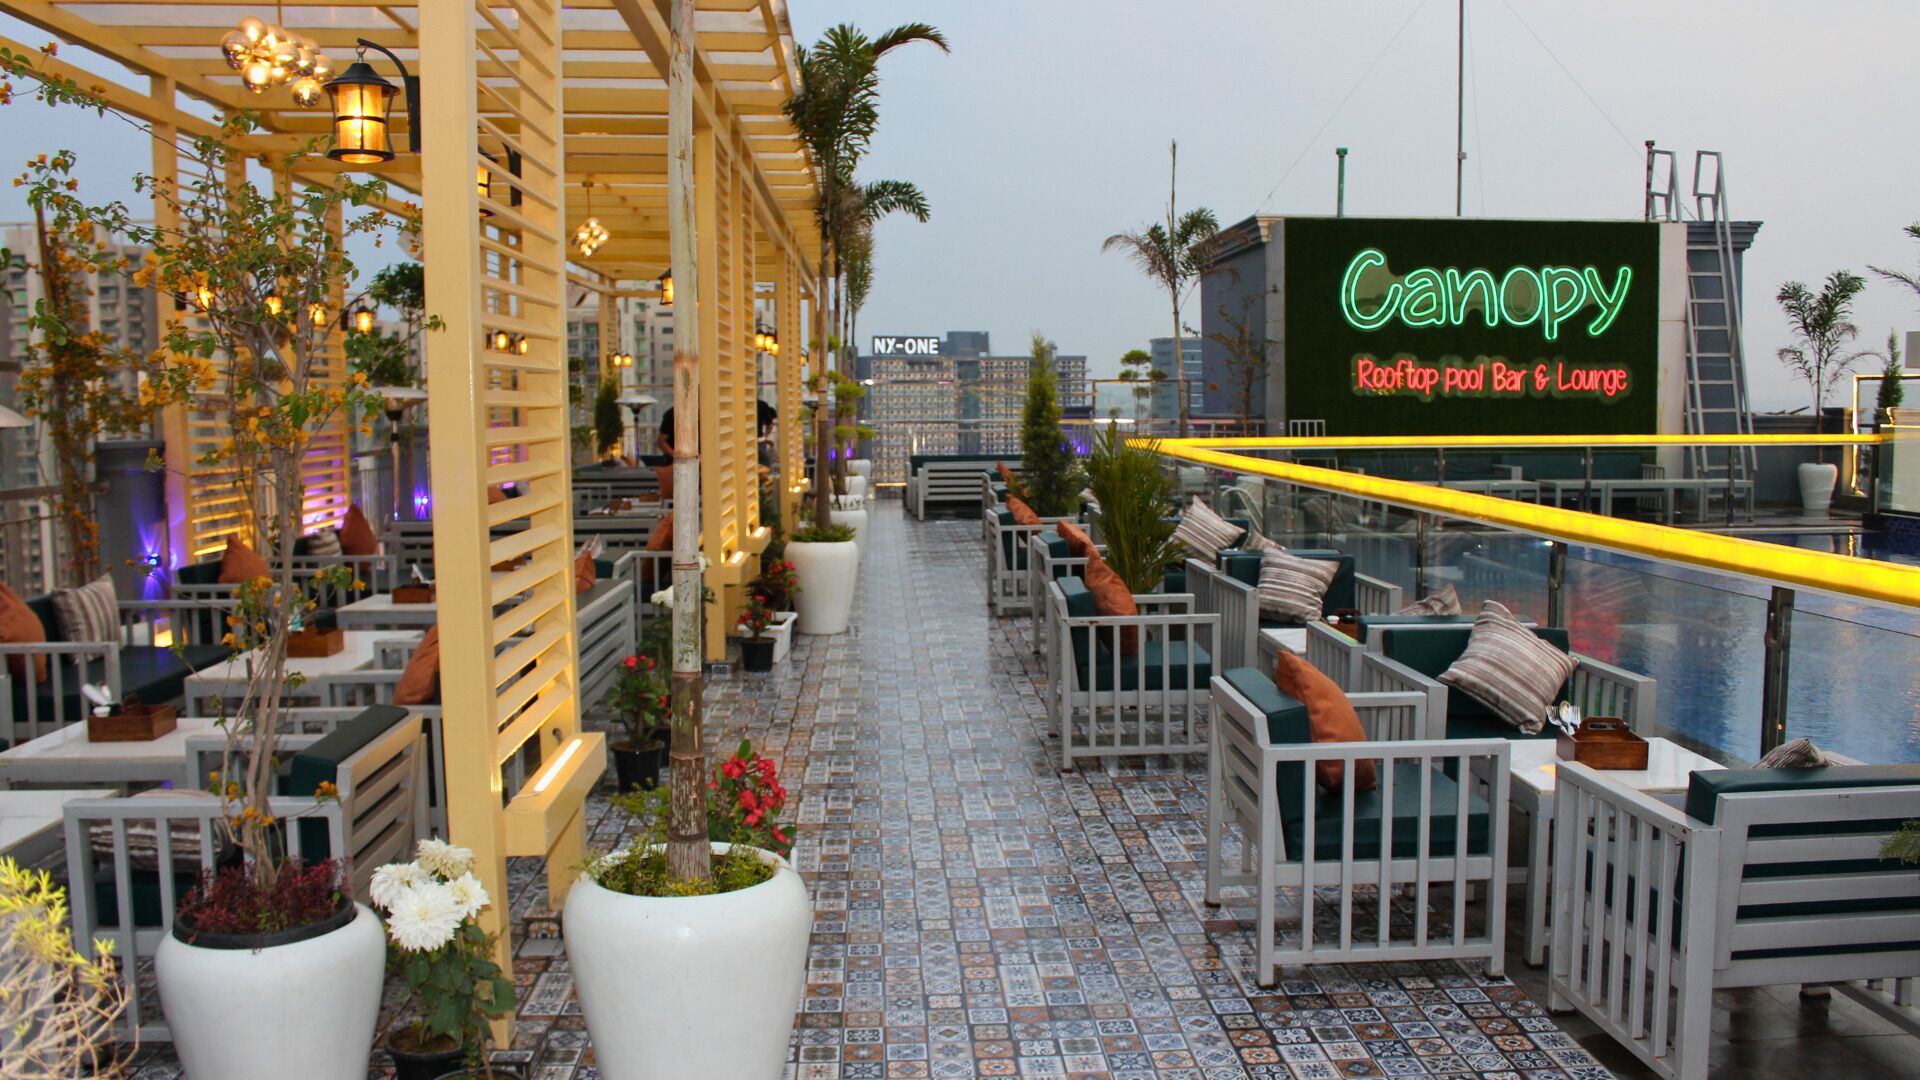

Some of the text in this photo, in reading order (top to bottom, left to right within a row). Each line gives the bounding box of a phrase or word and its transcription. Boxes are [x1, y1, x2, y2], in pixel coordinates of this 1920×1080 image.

[1341, 249, 1632, 340] Canopy
[874, 338, 939, 354] NX-ONE
[1357, 359, 1628, 397] Rooftop pool Bar & Lounge
